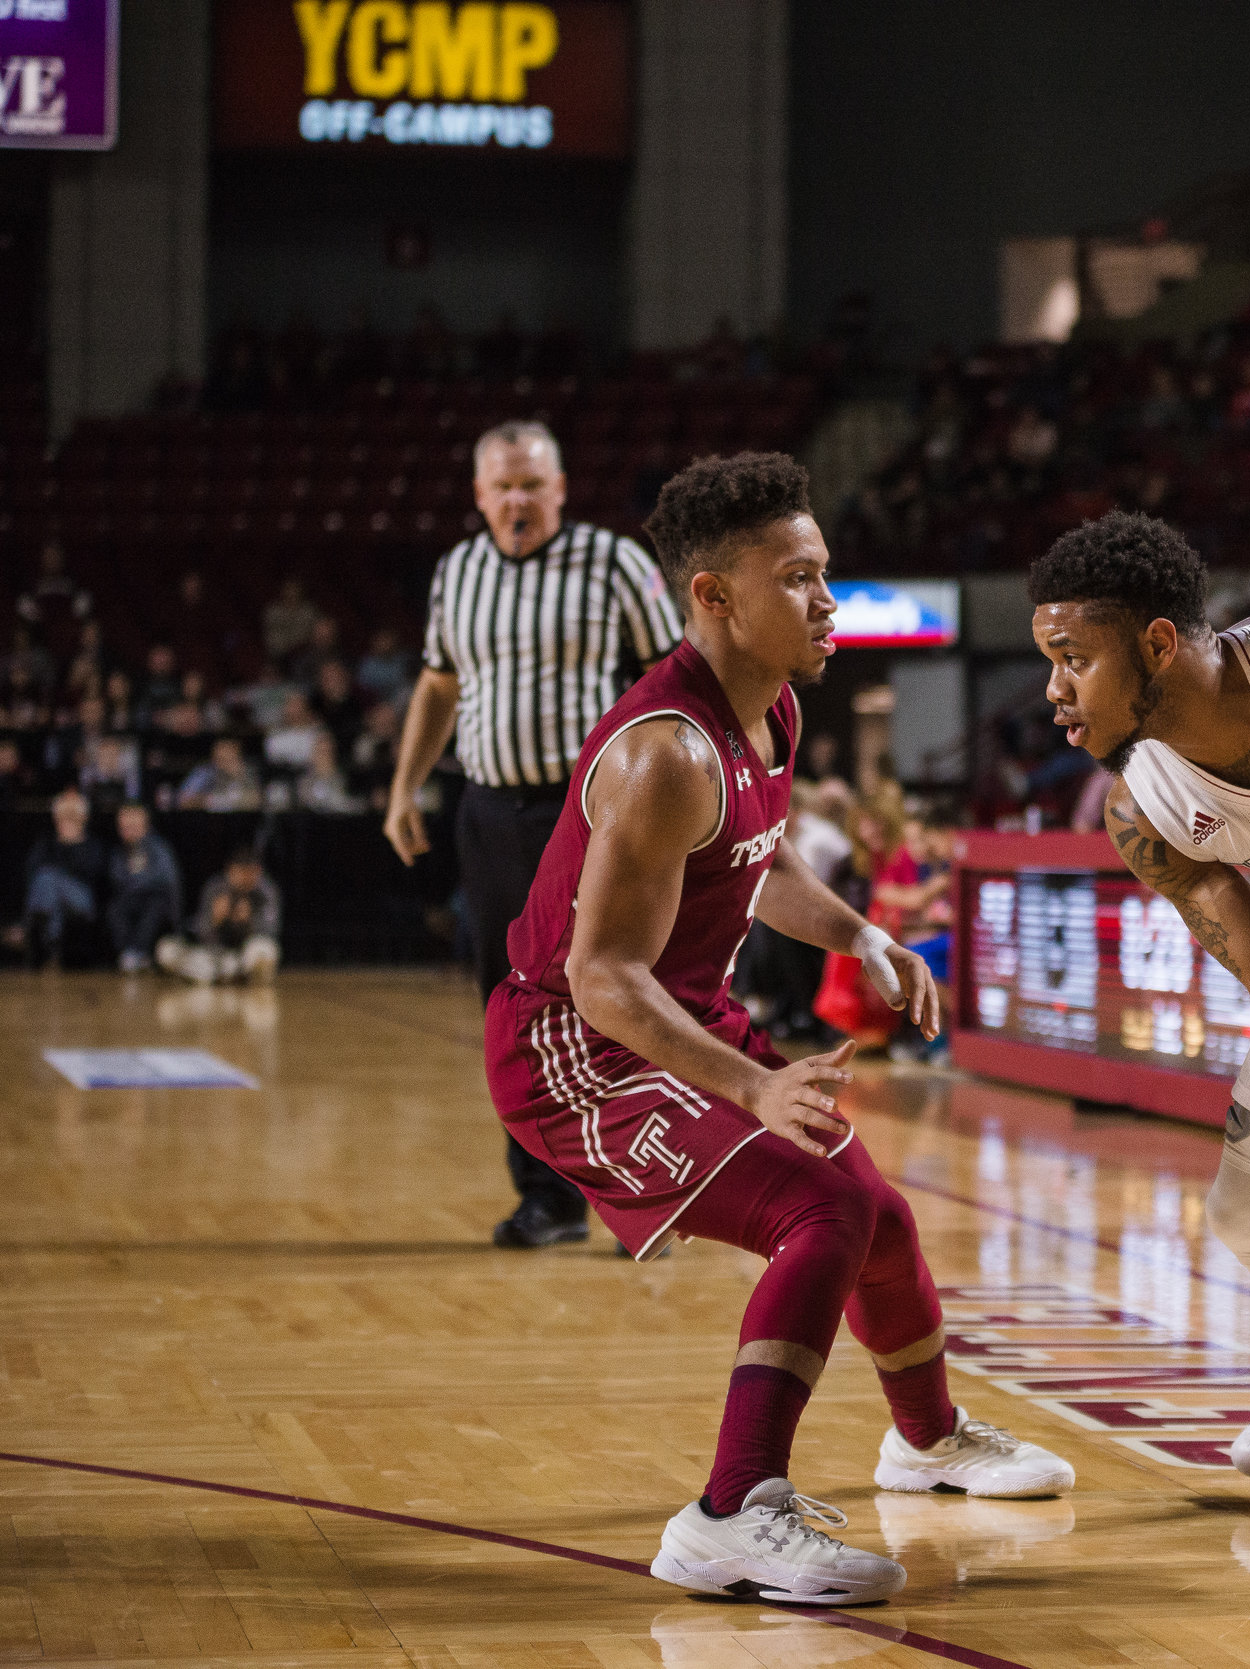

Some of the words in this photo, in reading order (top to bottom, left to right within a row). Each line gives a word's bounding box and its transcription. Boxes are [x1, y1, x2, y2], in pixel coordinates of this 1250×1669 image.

[294, 0, 557, 102] YCMP
[299, 99, 553, 148] OFF-CAMPUS
[1193, 818, 1226, 846] adidas
